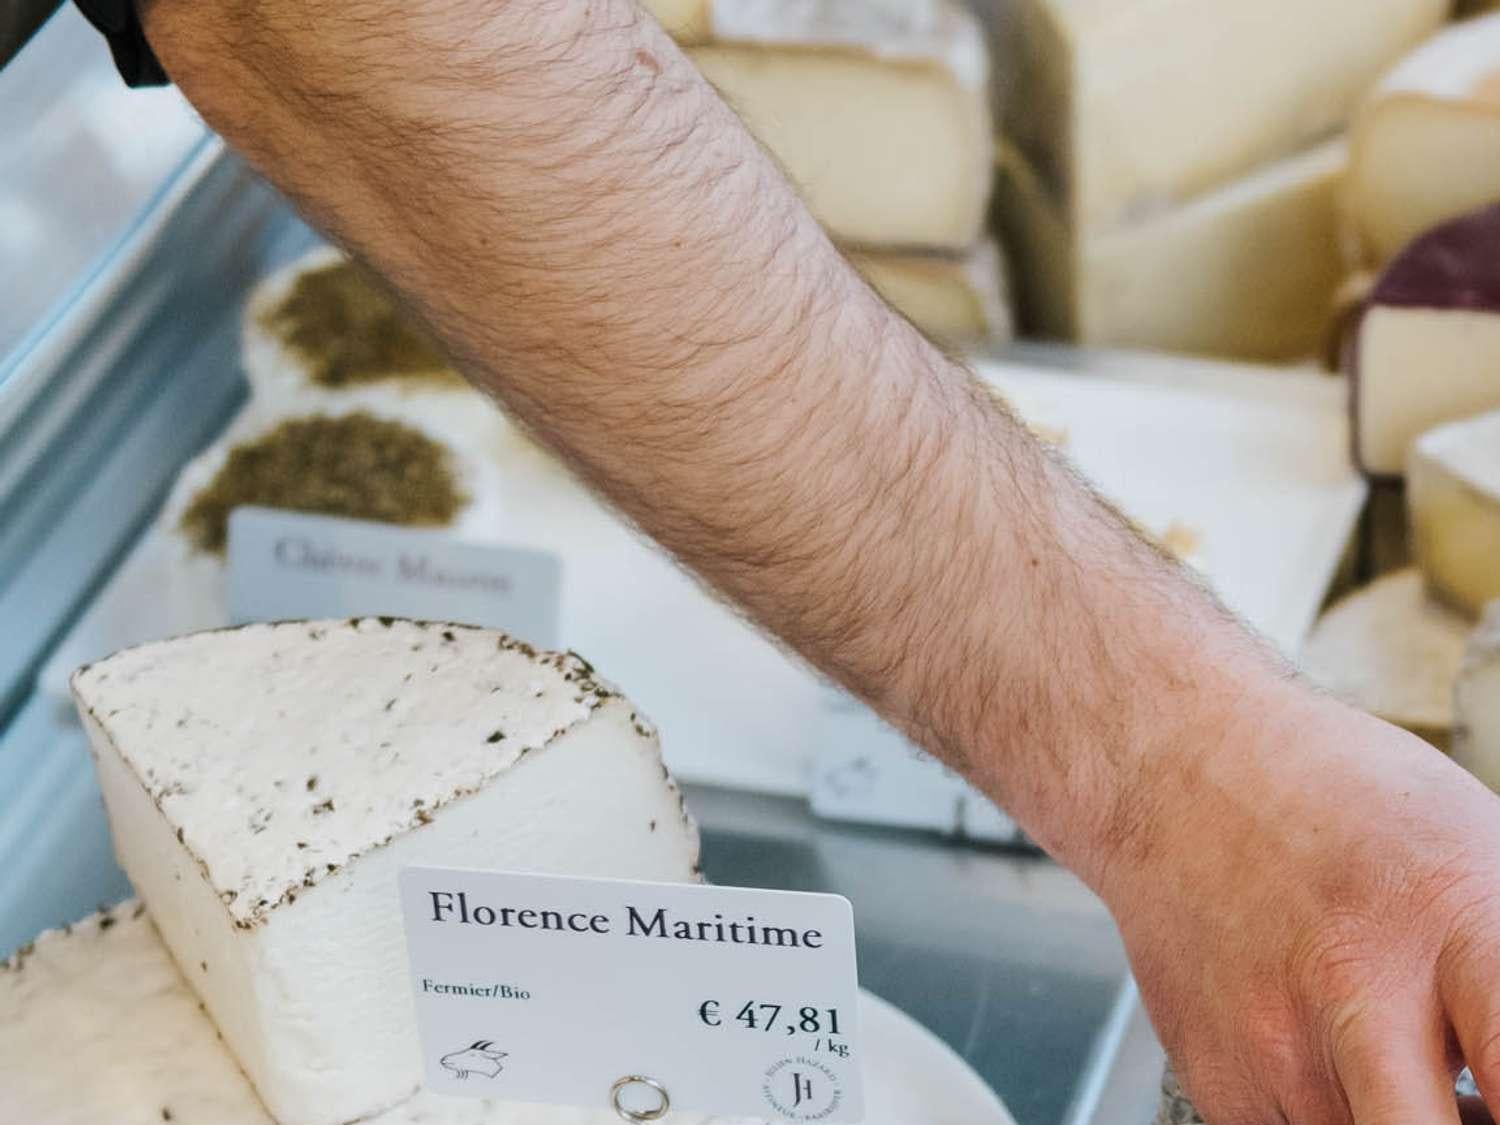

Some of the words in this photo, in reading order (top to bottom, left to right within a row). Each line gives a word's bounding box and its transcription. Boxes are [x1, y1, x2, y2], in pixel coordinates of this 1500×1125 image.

[428, 891, 610, 934] Florence
[625, 905, 824, 949] Maritime
[422, 978, 531, 1001] Fermier/Bio
[698, 999, 722, 1027] €
[735, 1000, 841, 1037] 47,81
